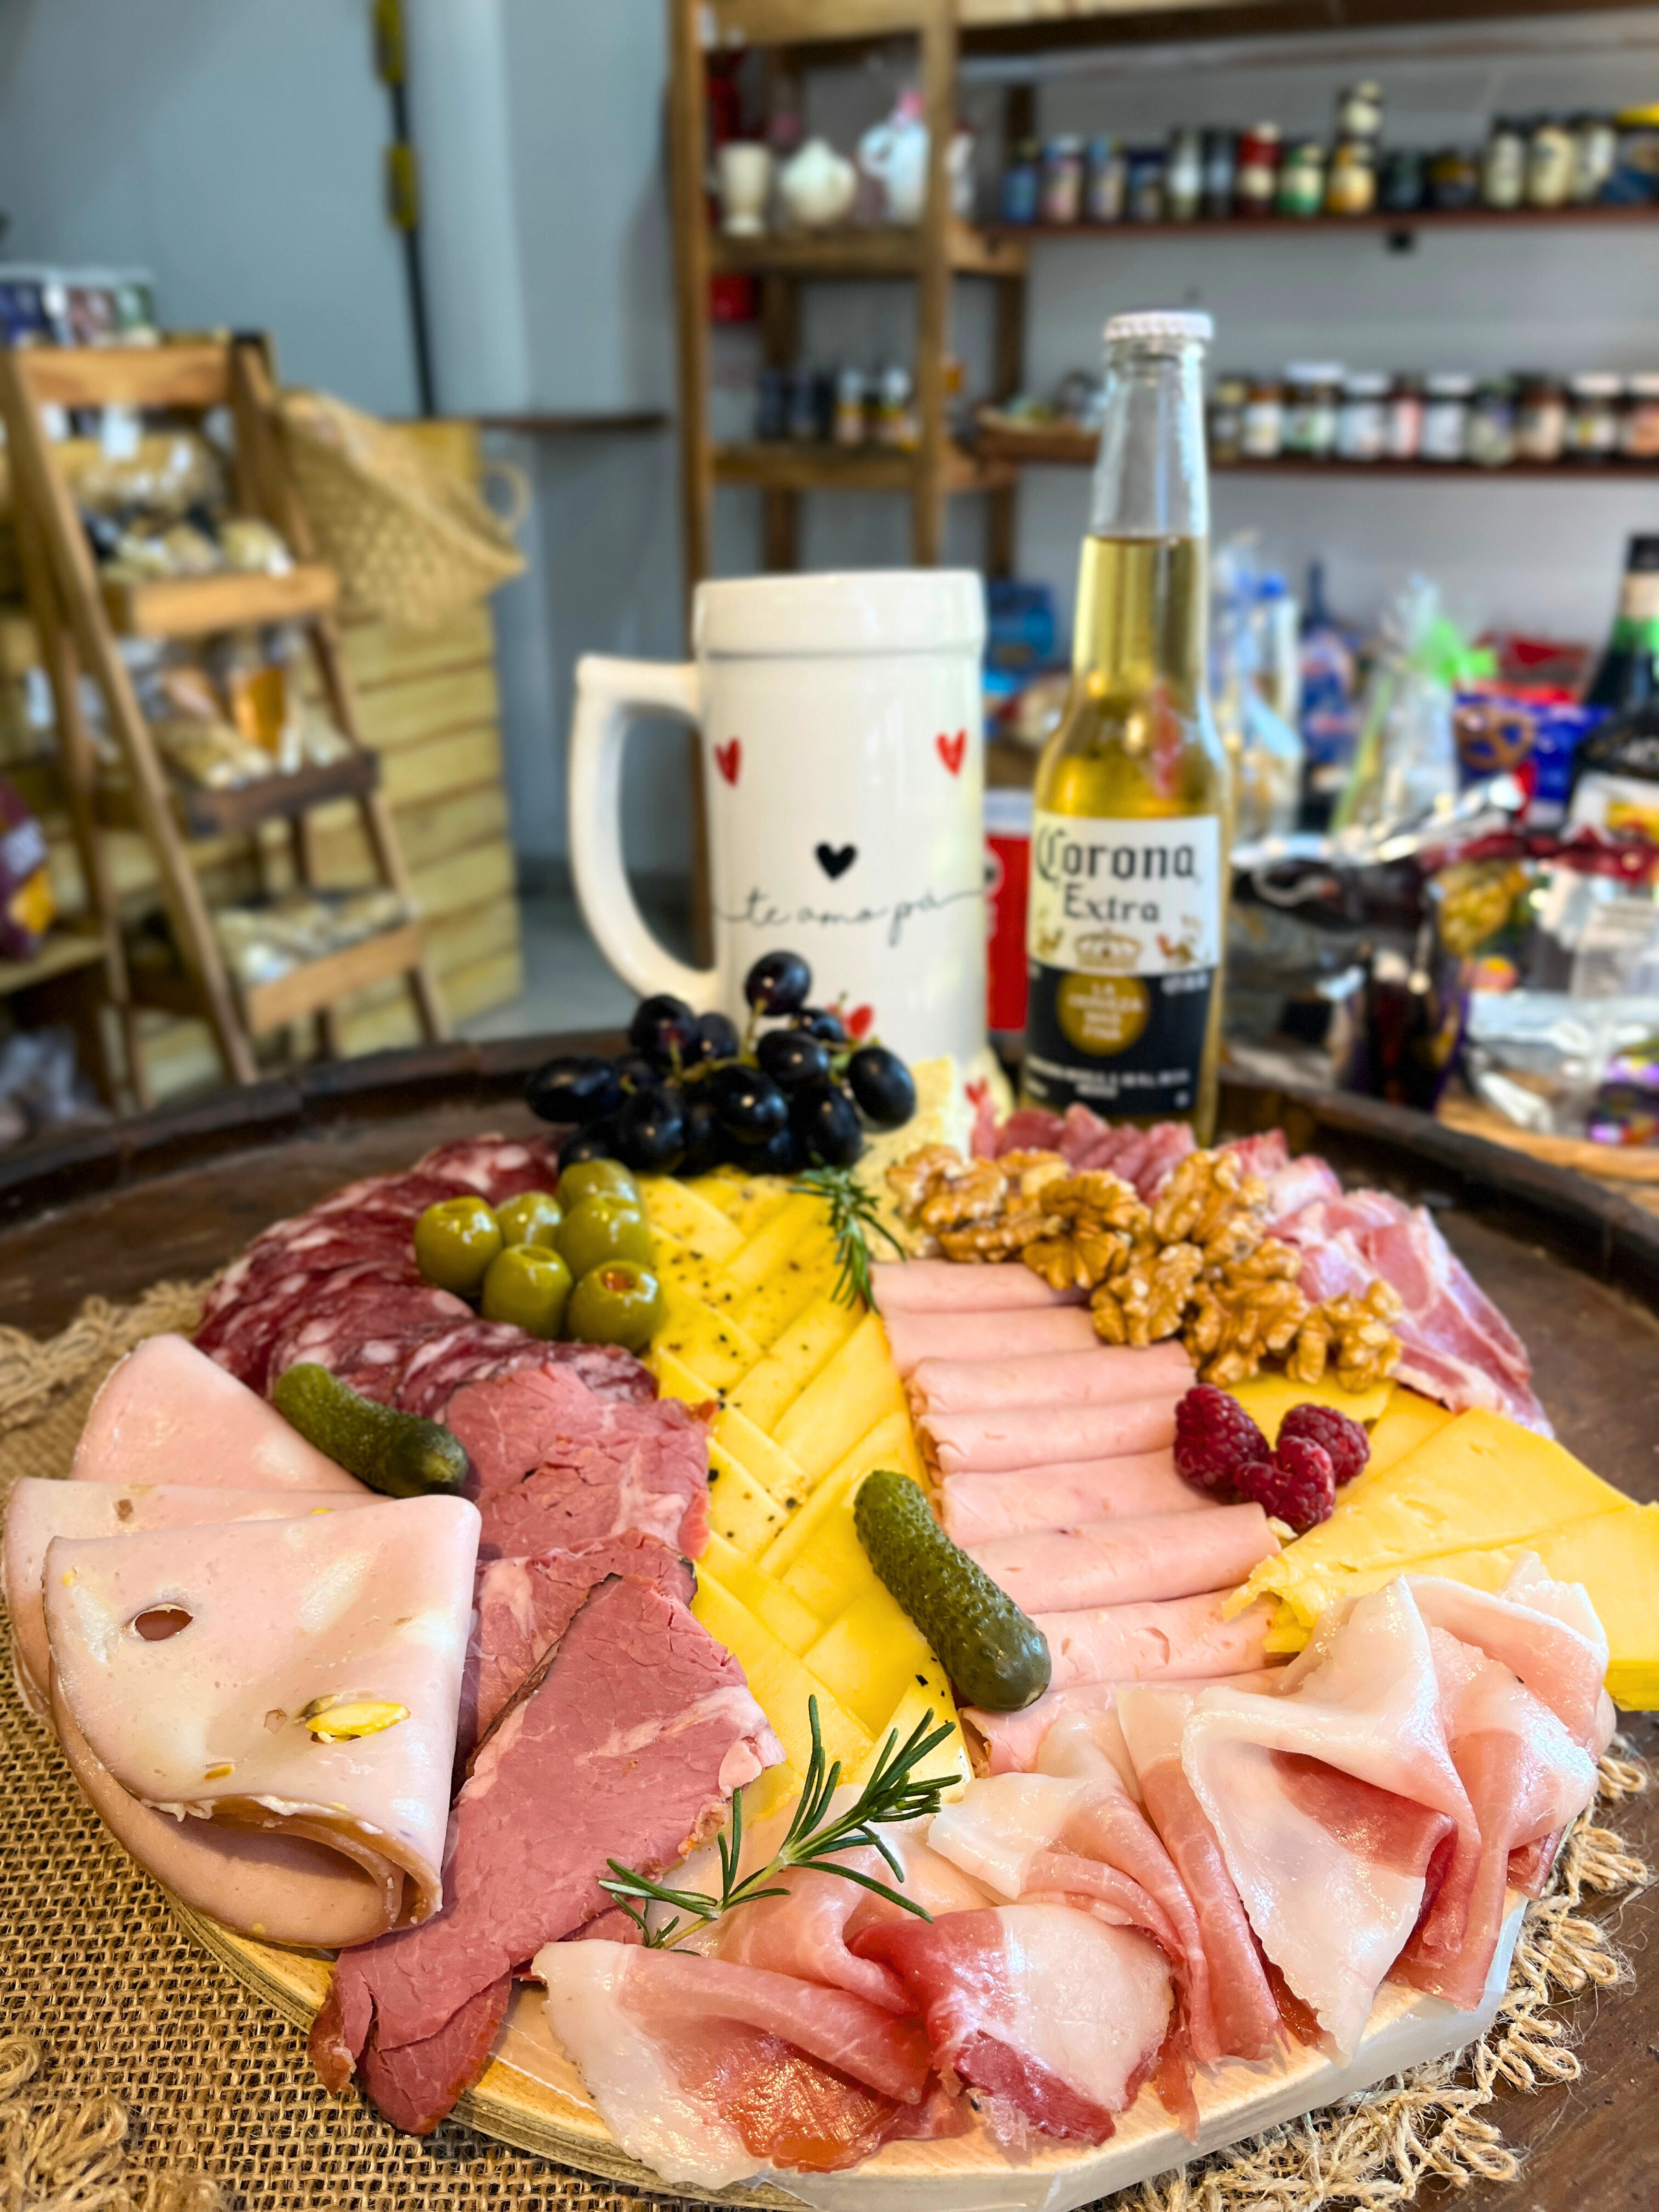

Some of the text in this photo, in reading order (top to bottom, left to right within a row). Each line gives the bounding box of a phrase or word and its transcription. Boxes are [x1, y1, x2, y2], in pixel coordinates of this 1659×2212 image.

[1034, 824, 1198, 883] Corona
[744, 887, 790, 926] te
[795, 905, 880, 926] amo
[1064, 882, 1160, 923] Extra
